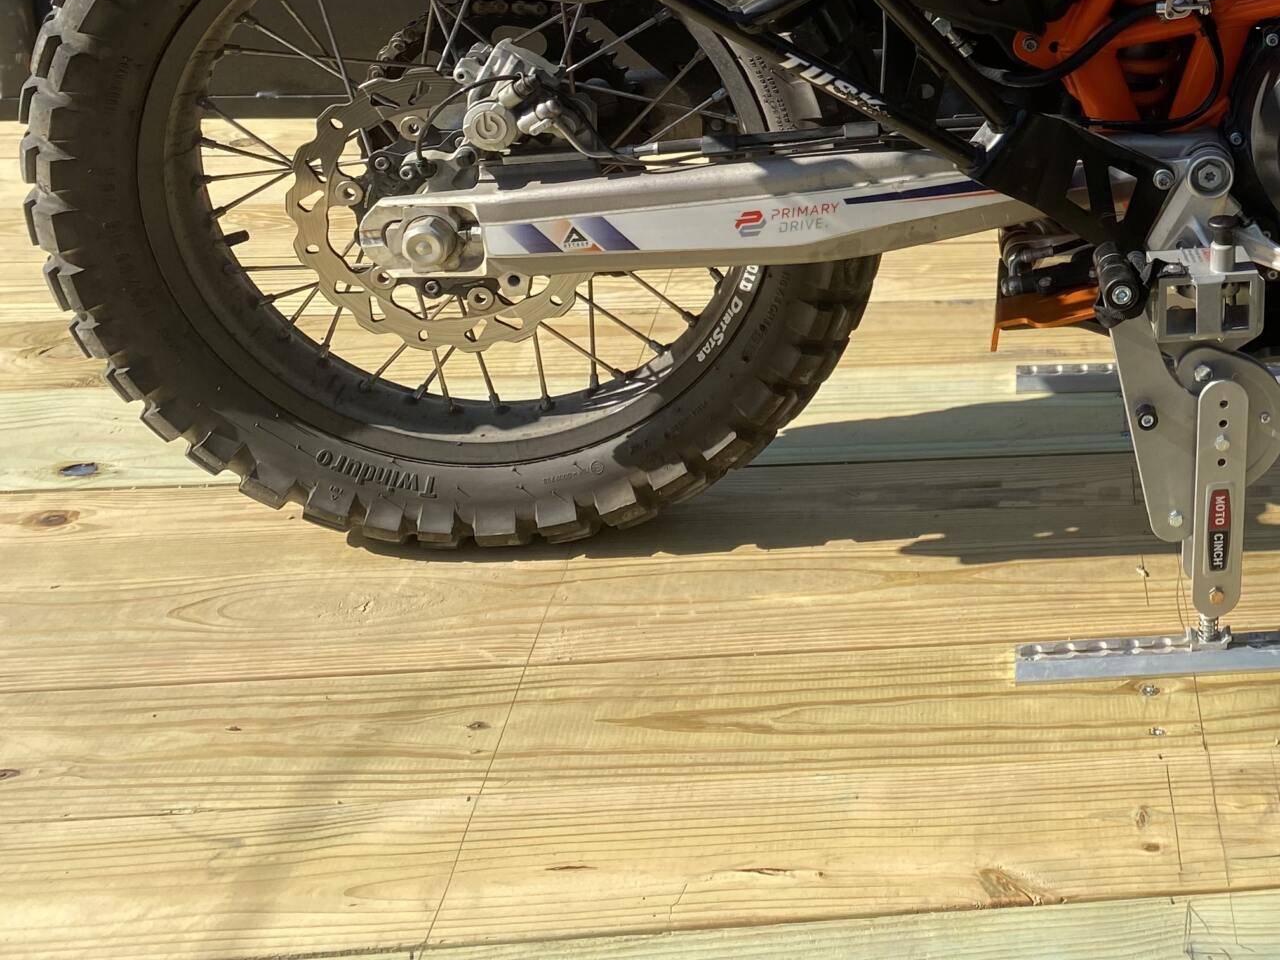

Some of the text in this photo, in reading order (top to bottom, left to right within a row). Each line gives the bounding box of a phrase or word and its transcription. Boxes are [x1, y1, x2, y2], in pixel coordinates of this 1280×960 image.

[779, 51, 889, 114] TUSK
[771, 203, 840, 220] PRIMARY
[779, 218, 829, 234] DRIVE
[316, 448, 439, 499] Twinduro
[1213, 495, 1226, 568] MOTO CINCH
